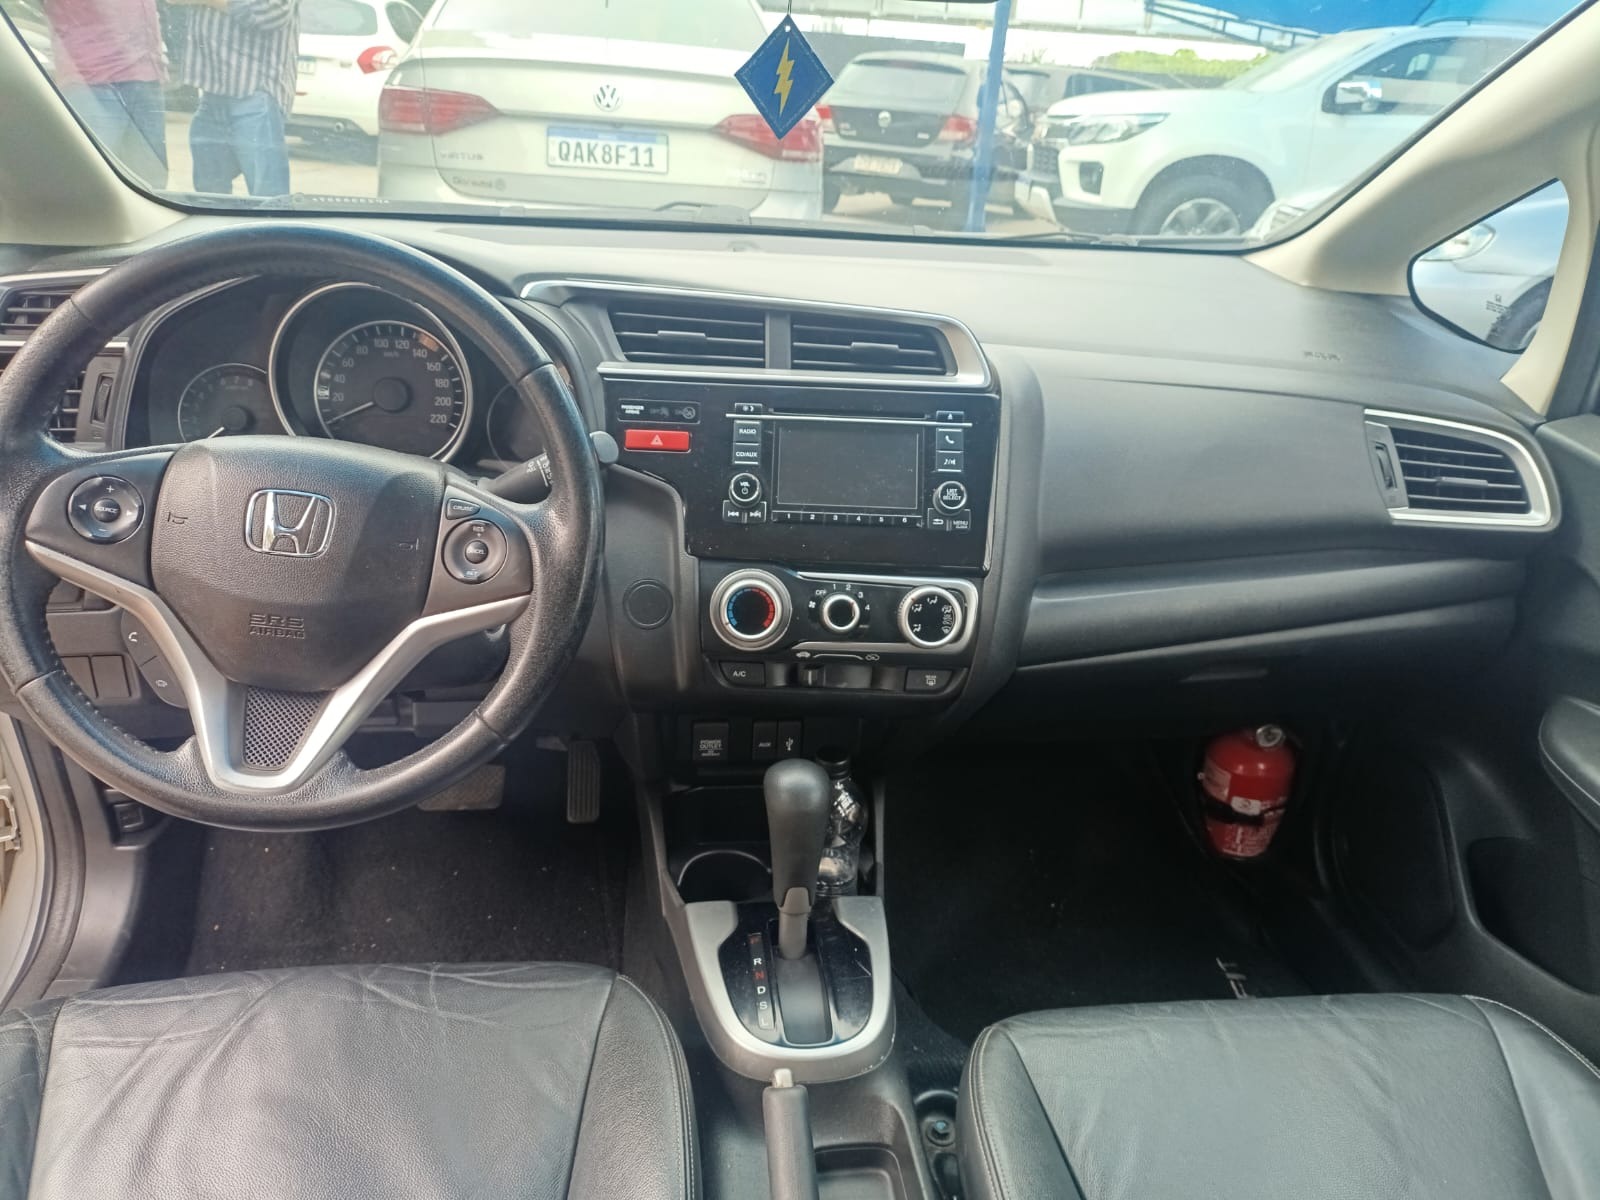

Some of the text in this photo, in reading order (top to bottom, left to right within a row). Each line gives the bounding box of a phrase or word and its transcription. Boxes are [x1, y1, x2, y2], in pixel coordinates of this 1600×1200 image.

[558, 139, 655, 168] QAK8F11
[395, 340, 410, 349] 120
[356, 345, 368, 355] 80
[412, 348, 428, 359] 140
[342, 358, 354, 368] 60
[426, 362, 441, 372] 160
[334, 374, 346, 384] 40
[434, 378, 450, 388] 180
[333, 392, 345, 402] 20
[434, 397, 452, 407] 200
[430, 414, 447, 424] 220
[857, 591, 864, 599] 3
[249, 613, 305, 628] SRS
[249, 627, 305, 640] AIRBAG
[732, 670, 747, 678] A/C
[753, 957, 762, 966] R
[755, 971, 765, 980] N
[757, 985, 766, 995] D
[759, 1001, 768, 1010] S
[762, 1018, 769, 1026] L
